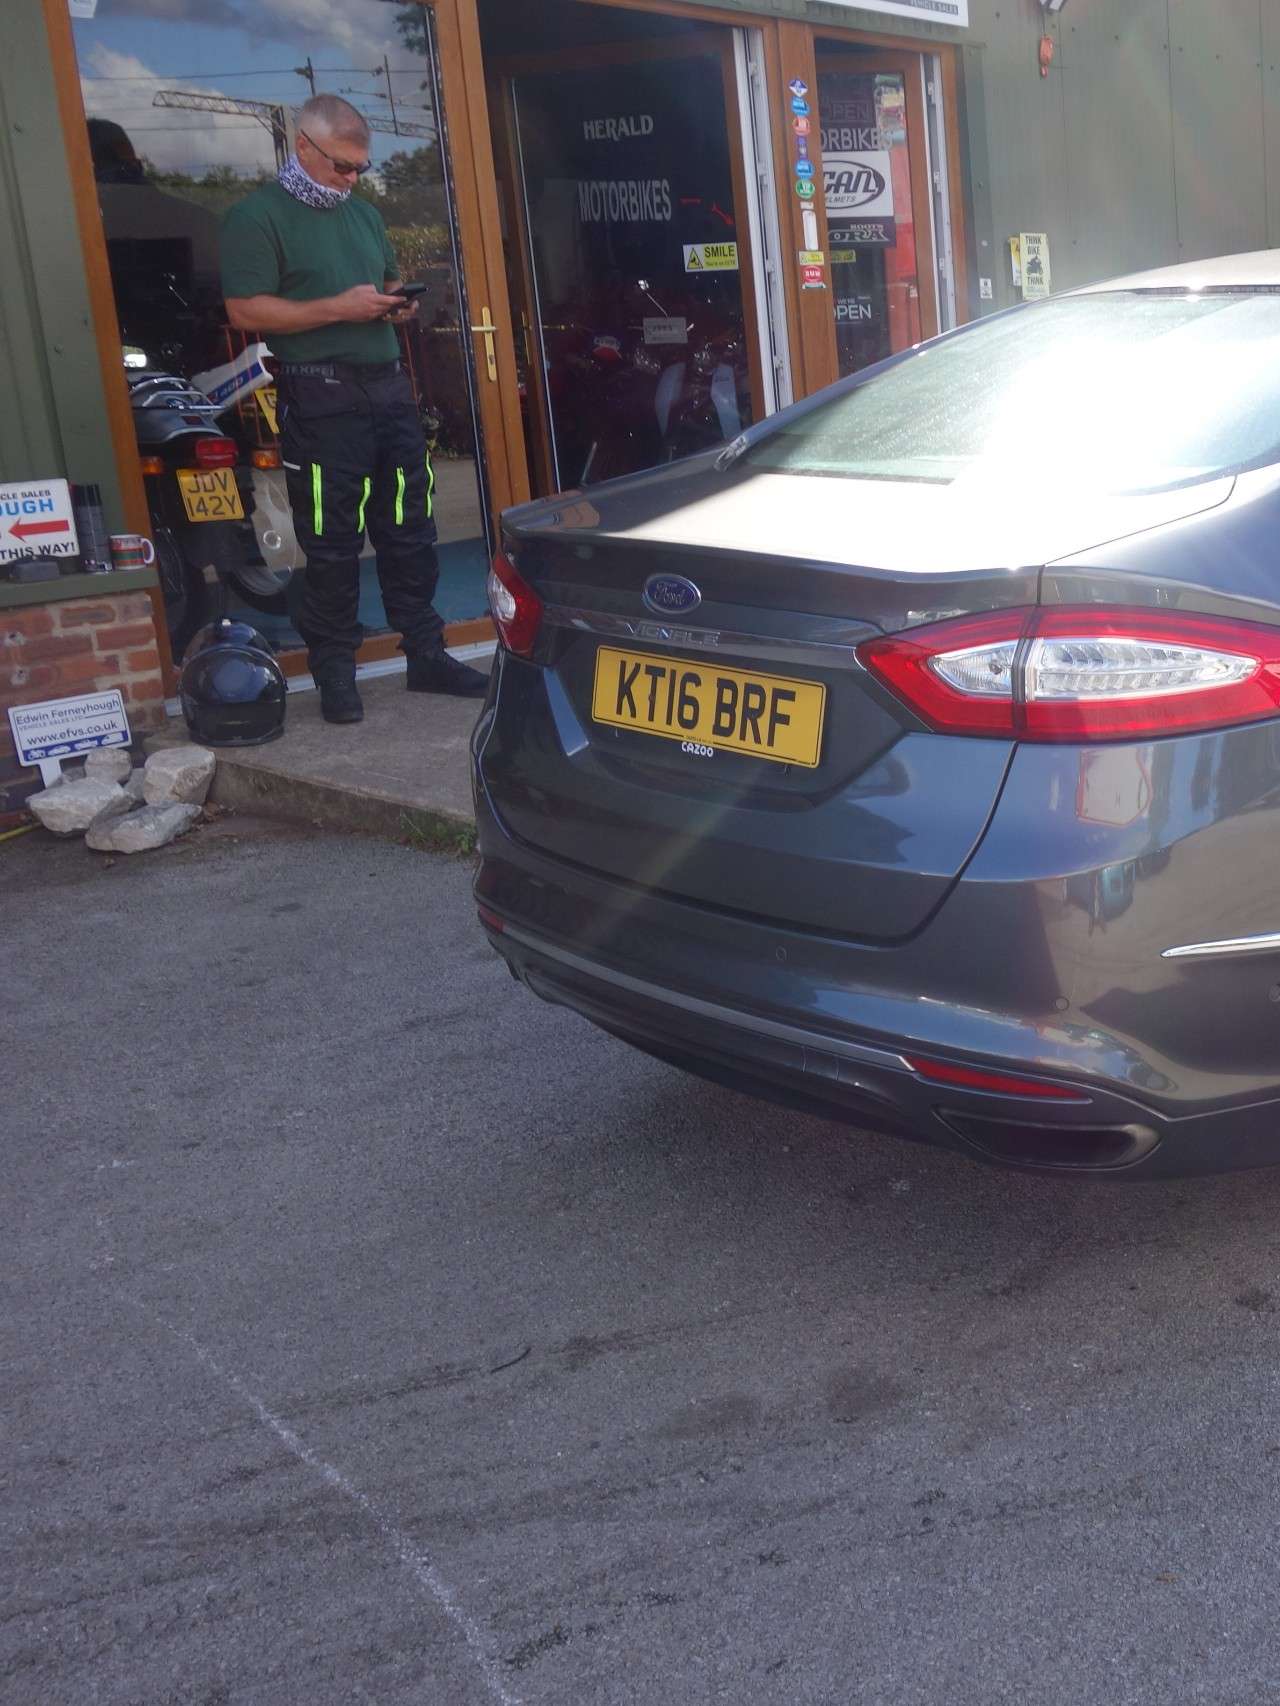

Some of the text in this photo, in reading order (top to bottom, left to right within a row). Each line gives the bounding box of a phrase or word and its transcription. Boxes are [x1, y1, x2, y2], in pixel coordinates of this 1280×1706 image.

[583, 115, 654, 141] HERALD
[578, 179, 672, 222] MOTORBIKES
[704, 245, 735, 258] SMILE
[1025, 235, 1042, 245] THINK
[1027, 245, 1040, 255] BIKE
[1027, 276, 1044, 286] THINK
[187, 471, 228, 494] JDV
[0, 489, 52, 501] CLE SALES
[188, 494, 237, 517] 142Y
[0, 498, 54, 516] UGH
[0, 541, 75, 560] THIS WAY!
[653, 582, 686, 606] Ford
[624, 621, 721, 647] VIGNALE
[15, 699, 120, 725] Edwin Ferneyhough
[616, 660, 796, 747] KT16 BRF
[27, 720, 117, 745] www.efvs.co.uk
[681, 741, 714, 758] CAZOO
